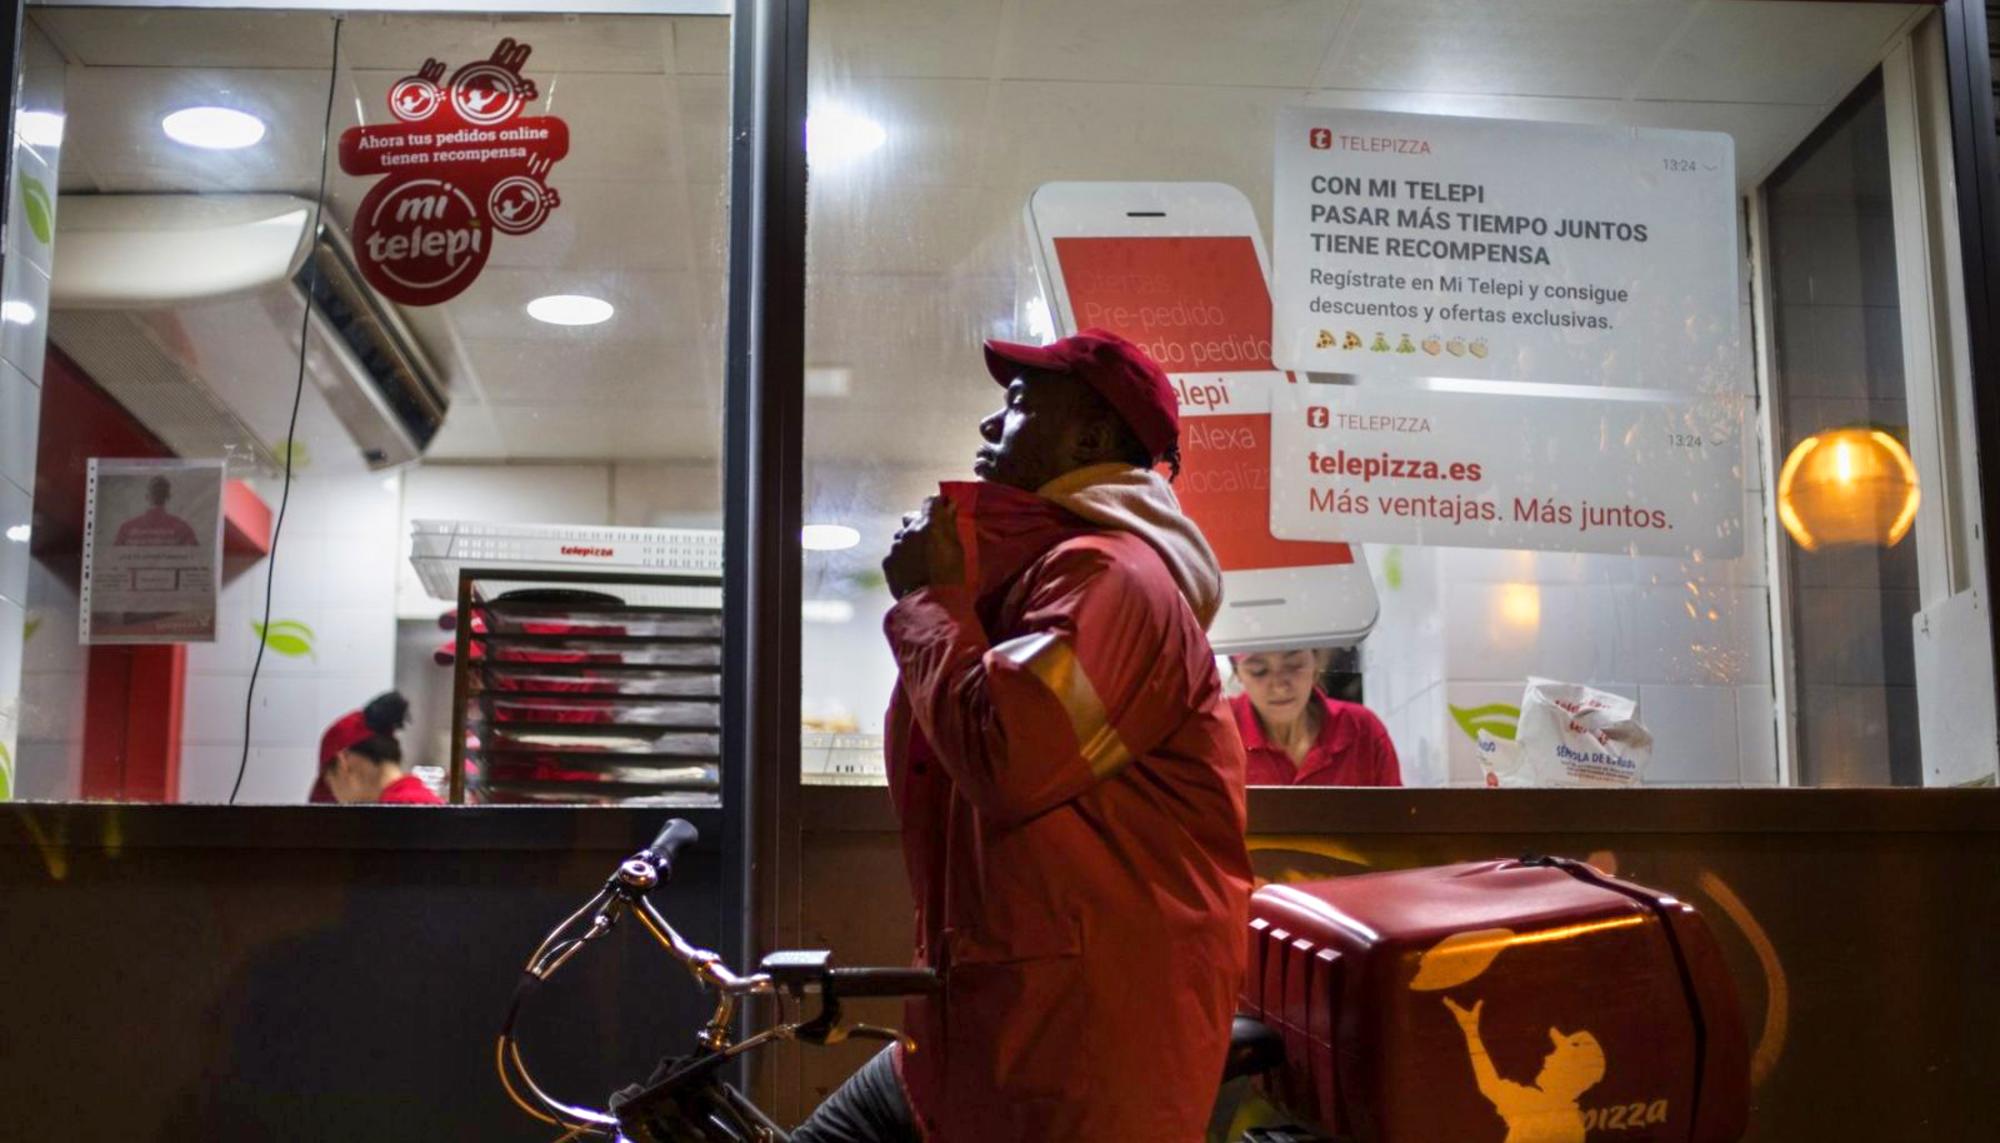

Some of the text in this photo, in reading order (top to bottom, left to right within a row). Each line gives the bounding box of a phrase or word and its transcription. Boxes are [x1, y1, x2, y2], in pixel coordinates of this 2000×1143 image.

[358, 126, 549, 150] Ahora tus pedidos online
[1339, 135, 1431, 154] TELEPIZZA
[381, 147, 527, 166] tienen recompensa
[1663, 158, 1697, 172] 13:24
[396, 182, 452, 222] mi
[1311, 175, 1484, 203] CON MI TELEPI
[1311, 204, 1648, 242] PASAR MÁS TIEMPO JUNTOS
[366, 220, 482, 266] telepi
[1310, 233, 1551, 265] TIENE RECOMPENSA
[1310, 268, 1629, 304] Regístrate en Mi Telepi y consigue
[1084, 299, 1226, 332] Pre-pedido
[1310, 296, 1614, 329] descuentos y ofertas exclusivas.
[1188, 422, 1257, 452] Alexa
[1337, 414, 1431, 432] TELEPIZZA
[1667, 434, 1702, 448] 13:24
[1308, 449, 1482, 482] telepizza.es
[1309, 487, 1673, 532] Más ventajas. Más juntos.
